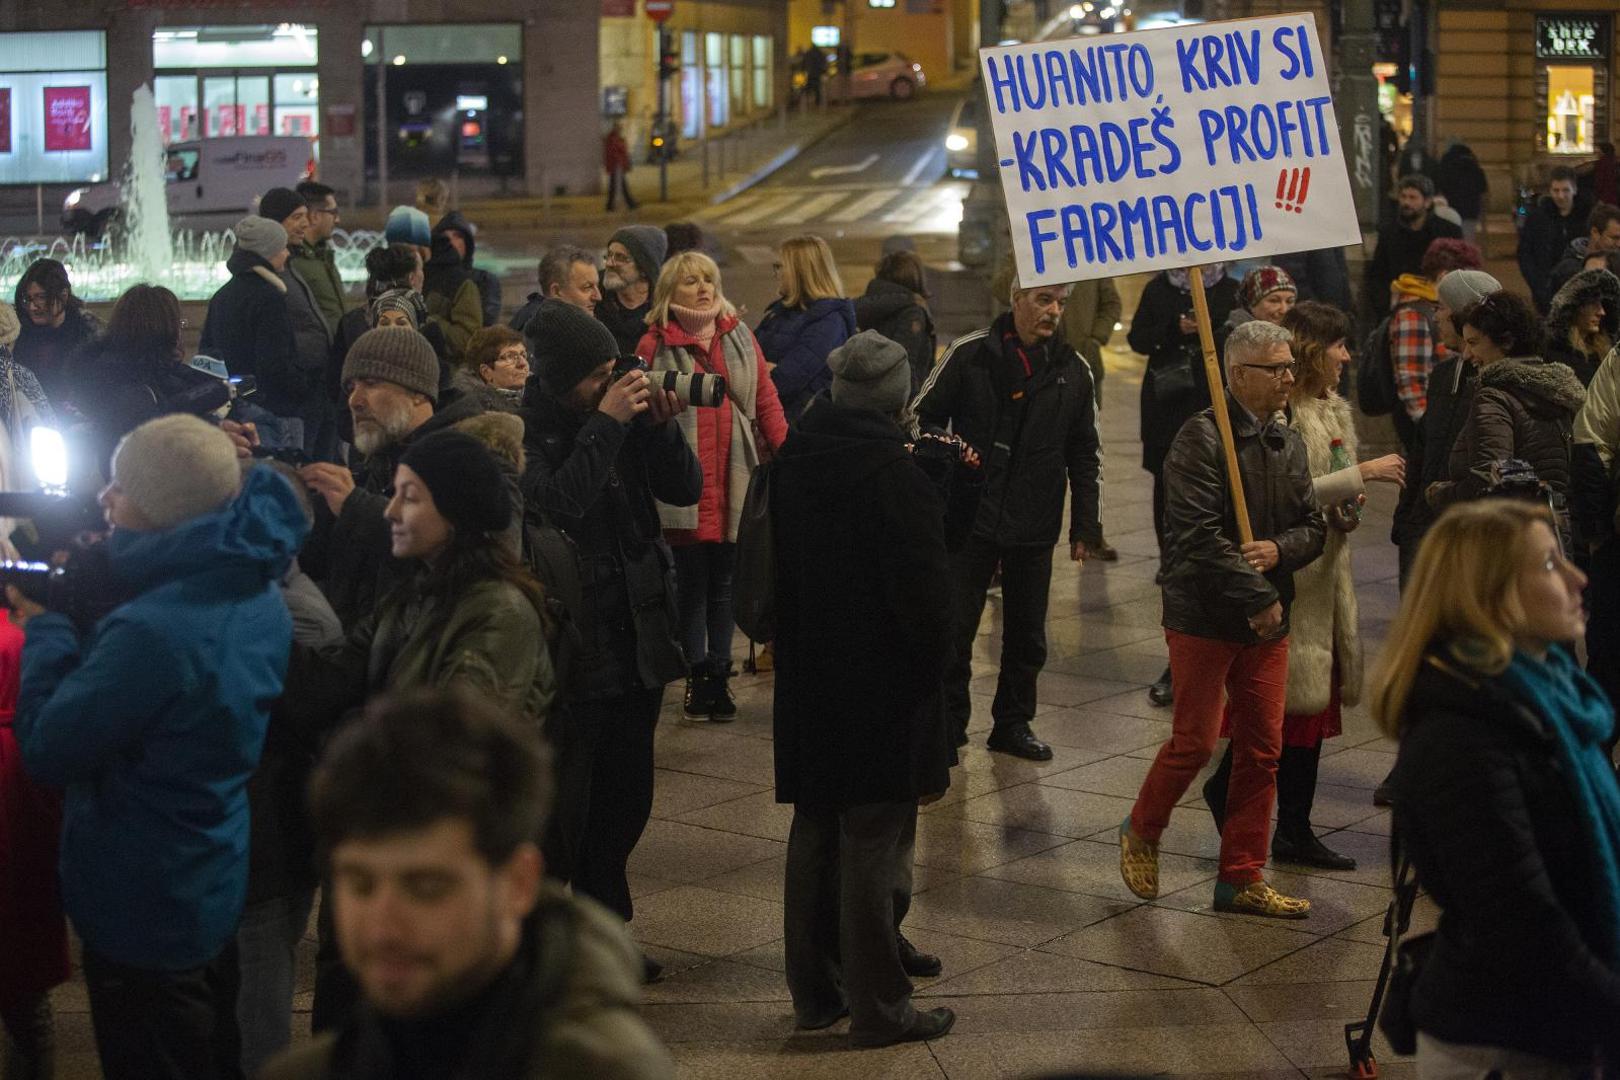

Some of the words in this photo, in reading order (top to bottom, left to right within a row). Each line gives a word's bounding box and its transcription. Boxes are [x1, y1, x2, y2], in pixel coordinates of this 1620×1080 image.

[987, 42, 1164, 114] HUANITO,
[1175, 29, 1262, 94] KRIV
[1272, 24, 1315, 79] SI
[1198, 96, 1331, 166] PROFIT
[1025, 183, 1264, 274] FARMACIJI
[1275, 166, 1312, 214] !!!
